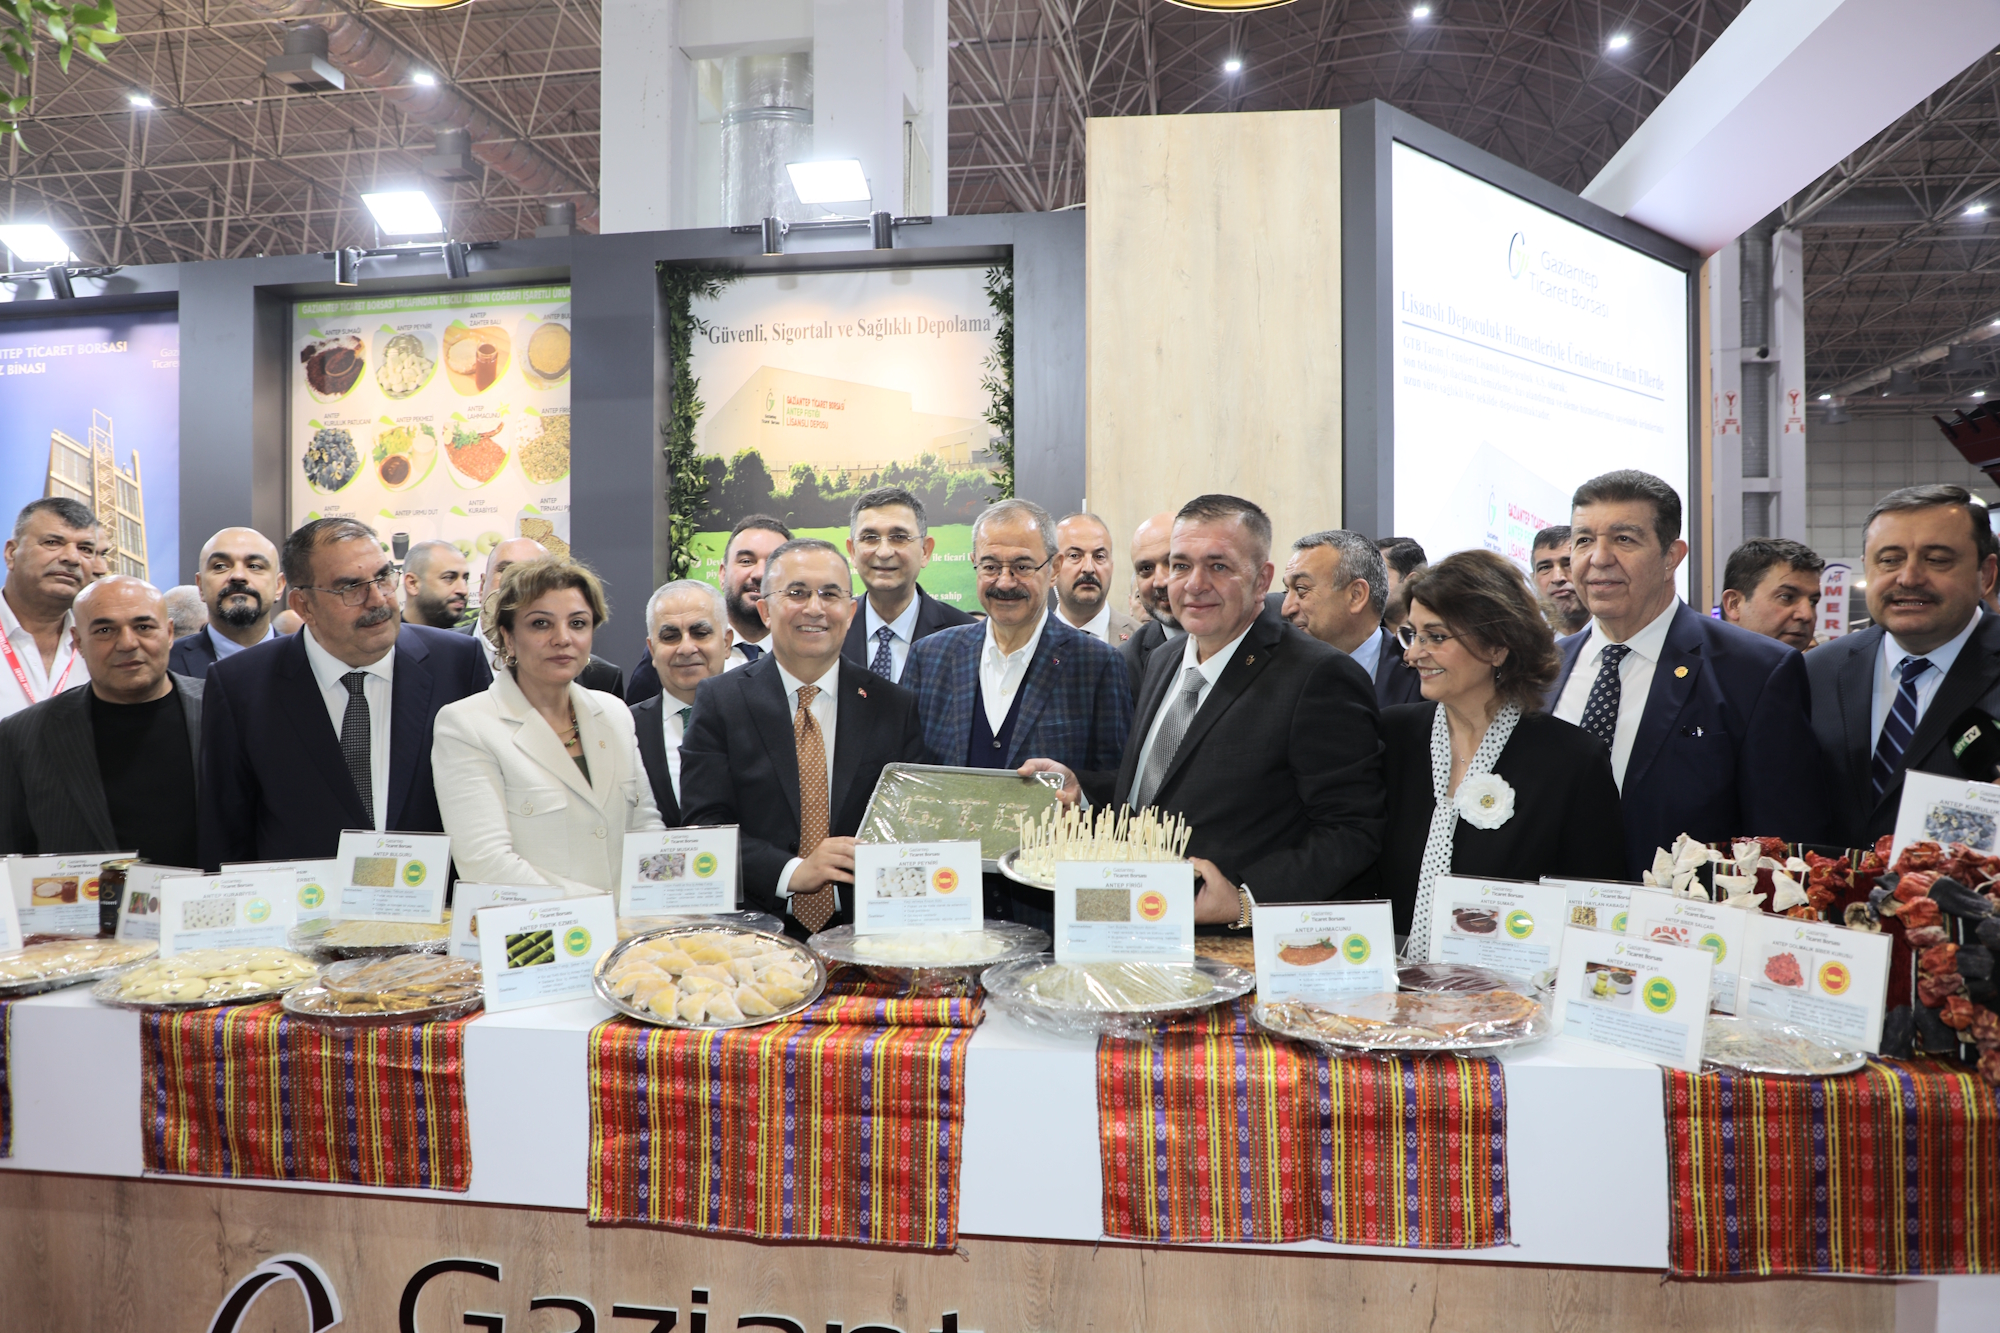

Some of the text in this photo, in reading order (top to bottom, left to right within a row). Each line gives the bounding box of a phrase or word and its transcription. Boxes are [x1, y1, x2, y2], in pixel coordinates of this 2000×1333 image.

[1541, 250, 1598, 294] Gaziantep
[302, 288, 551, 315] GAZİANTEP TİCARET BORSASI TARAFINDAN ALINAN COĞRAFİ İŞARETLİ
[1529, 271, 1609, 318] Ticaret Borsası
[772, 320, 833, 346] Sigortalı
[837, 324, 854, 338] ve
[857, 317, 912, 342] Sağlıklı
[1401, 291, 1665, 391] Lisanslı Depoculuk Hizmetleriyle Ürünleriniz Emin Ellerde
[1402, 335, 1422, 351] GTB
[1423, 340, 1444, 358] Tarım
[25, 340, 127, 358] TİCARET BORSASI
[7, 361, 46, 376] BİNASI
[1402, 356, 1416, 369] son
[1417, 359, 1449, 380] teknoloji
[1402, 375, 1422, 389] uzun
[1422, 378, 1438, 393] süre
[1465, 388, 1475, 402] bir
[786, 395, 811, 407] GAZİANTEP
[812, 398, 828, 409] TİCARET
[786, 407, 804, 417] ANTEP
[810, 419, 829, 430] DEPOSU
[932, 552, 966, 562] ile ticari
[940, 591, 963, 603] sahip
[1939, 799, 2000, 816] ANTEP KURULUK
[899, 858, 938, 868] ANTEP PEYNİRİ
[1126, 881, 1143, 889] FİRİĞİ
[519, 918, 579, 932] ANTEP FISTIK EZMESİ
[1665, 916, 1680, 924] ANTEP
[1294, 925, 1351, 934] ANTEP LAHMACUNU
[1772, 940, 1788, 948] ANTEP
[1606, 958, 1623, 966] ANTEP
[1624, 960, 1645, 970] ZAHTER
